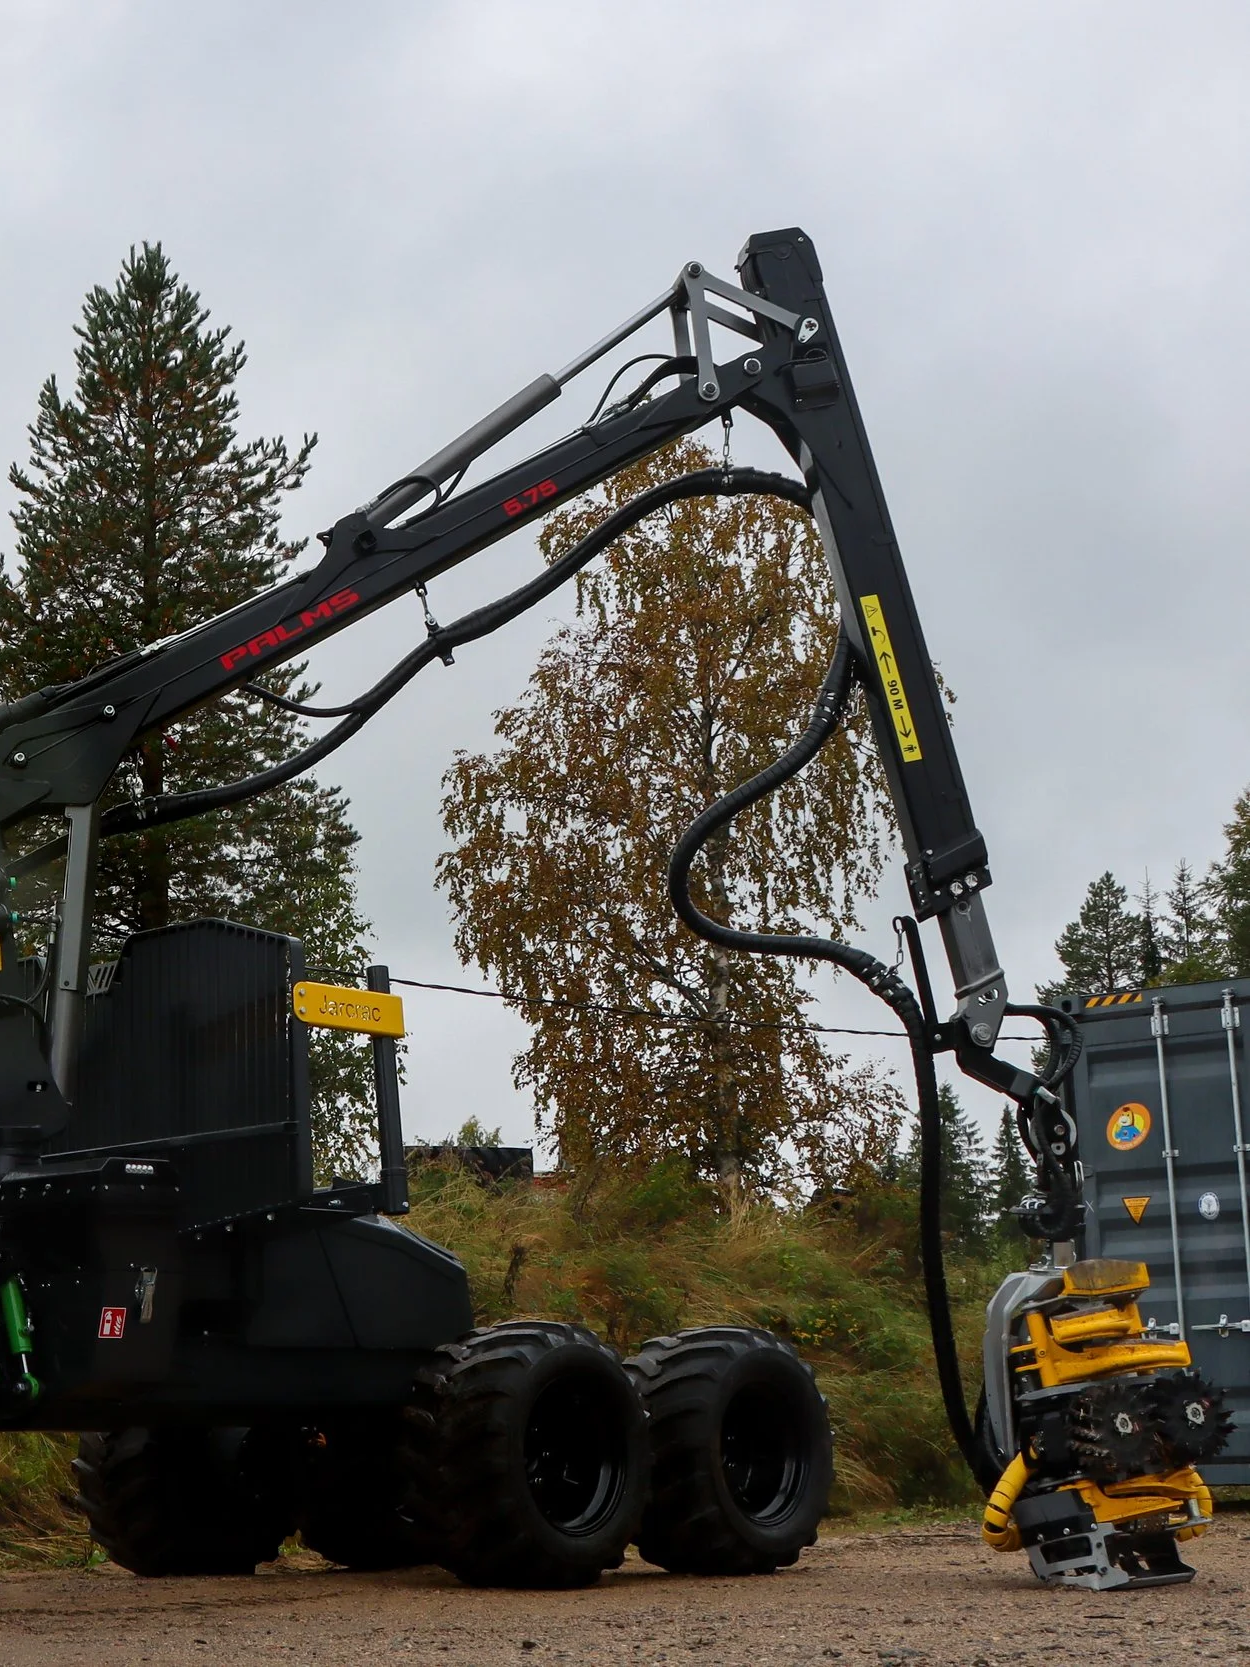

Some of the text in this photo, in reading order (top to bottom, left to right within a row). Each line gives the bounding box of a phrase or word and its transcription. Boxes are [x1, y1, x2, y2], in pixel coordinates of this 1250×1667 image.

[502, 479, 558, 517] 5.75
[220, 588, 361, 671] PALMS
[888, 680, 904, 710] 90 M
[319, 994, 382, 1022] Jarcrac
